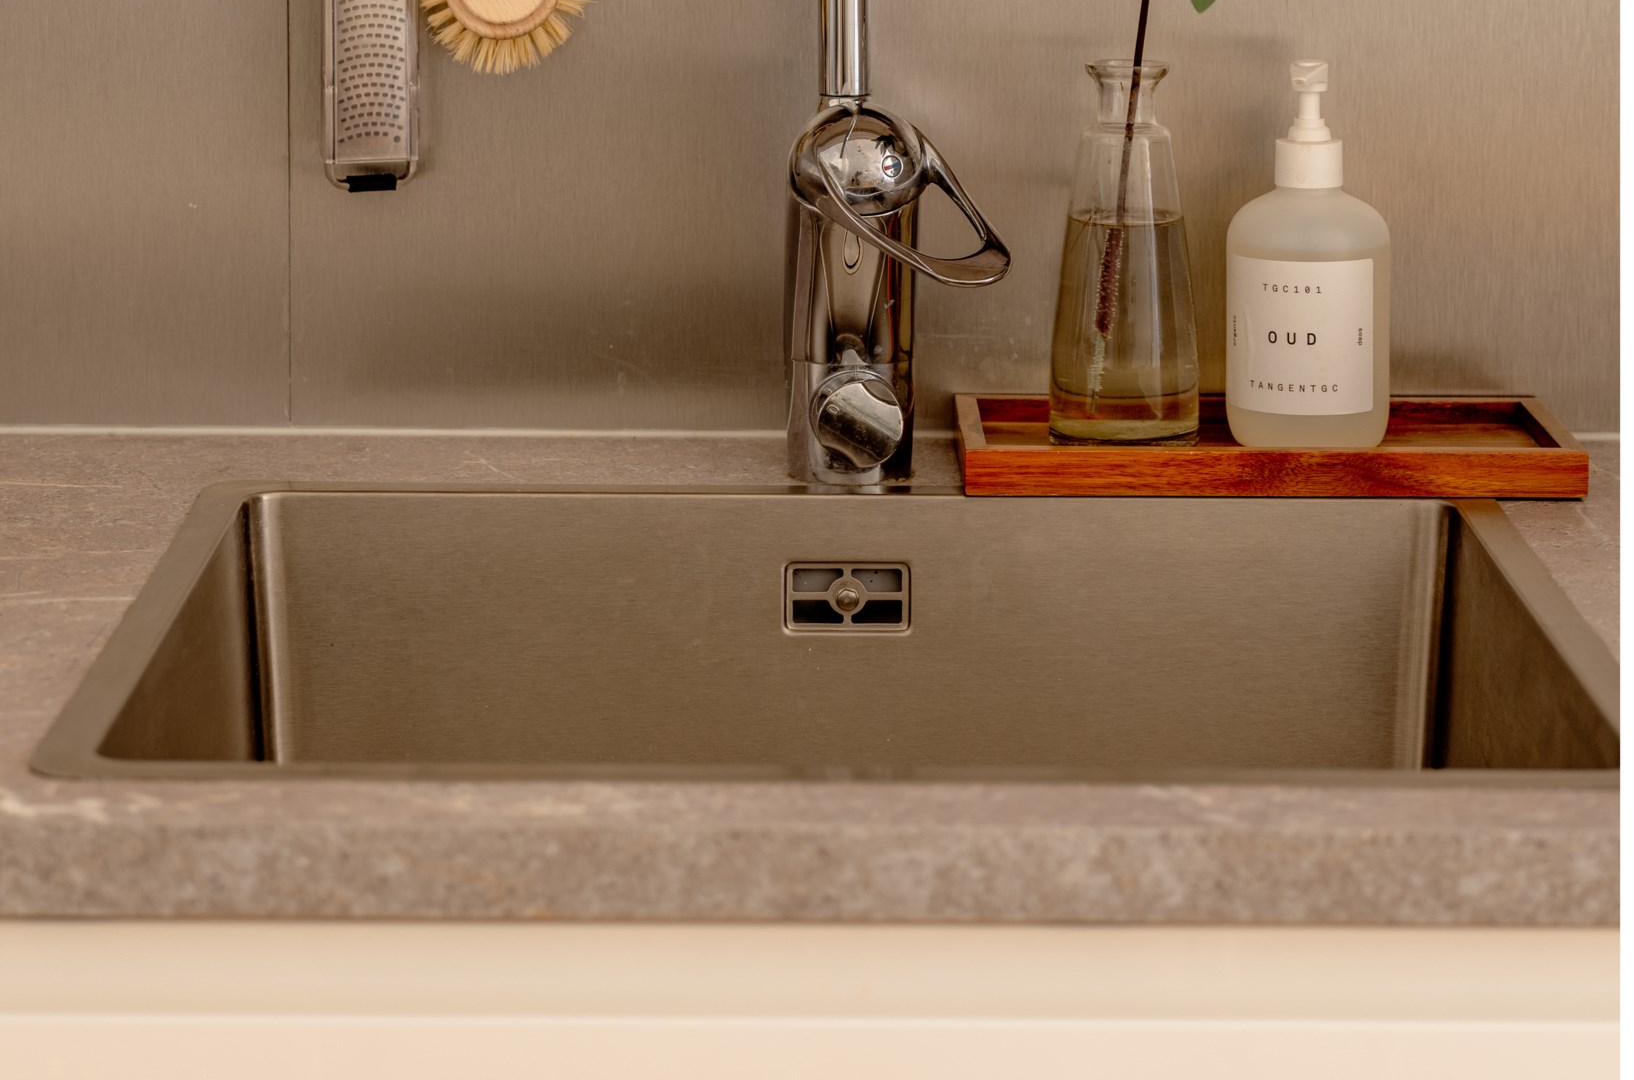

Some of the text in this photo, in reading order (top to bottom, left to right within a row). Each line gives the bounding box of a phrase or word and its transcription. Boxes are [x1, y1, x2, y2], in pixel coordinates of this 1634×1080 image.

[1262, 283, 1323, 294] TGC101
[1267, 330, 1317, 346] OUD
[1250, 379, 1339, 393] TANGENTGC
